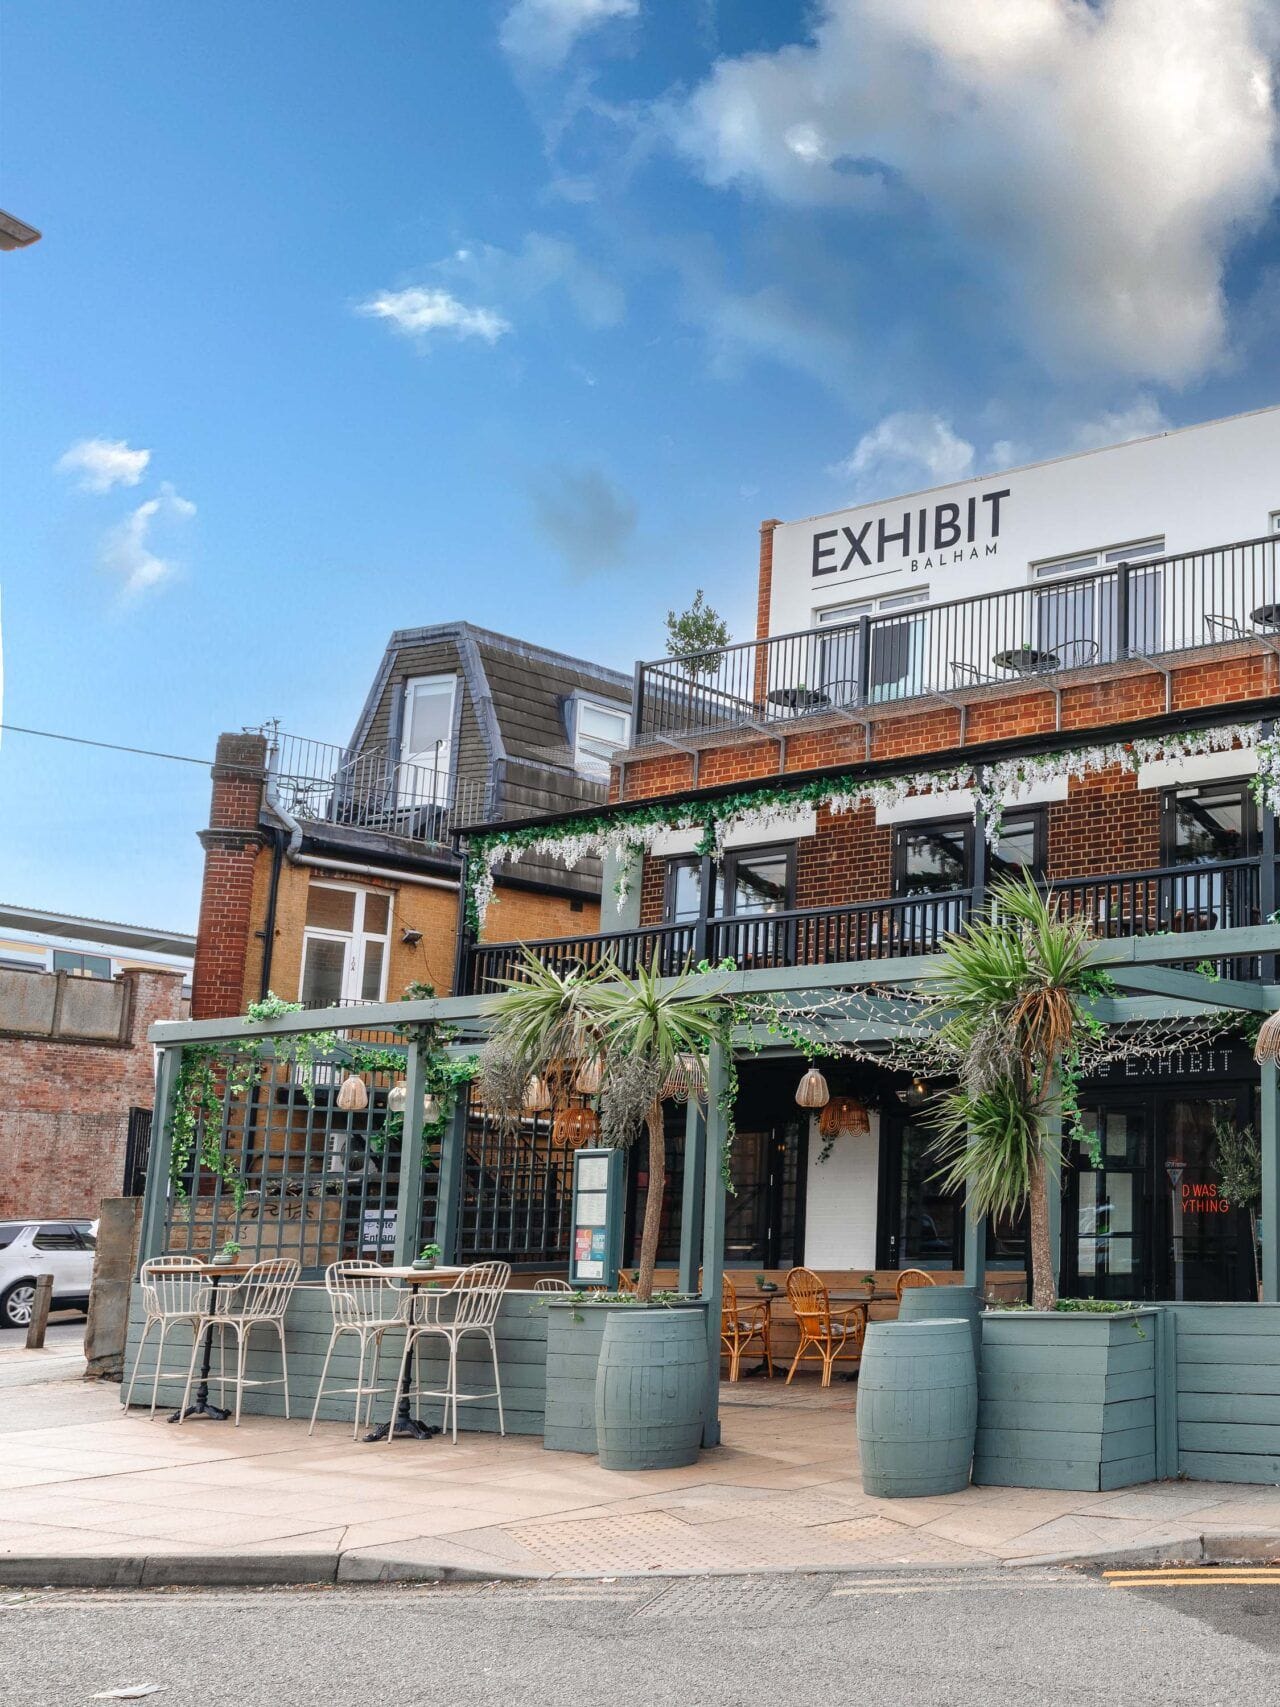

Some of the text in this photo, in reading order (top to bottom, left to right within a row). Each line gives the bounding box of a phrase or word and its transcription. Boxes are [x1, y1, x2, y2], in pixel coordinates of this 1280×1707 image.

[811, 488, 1011, 577] EXHIBIT
[910, 542, 998, 573] BALHAM
[1126, 1050, 1233, 1076] EXHIBIT
[1192, 1184, 1217, 1197] WAS
